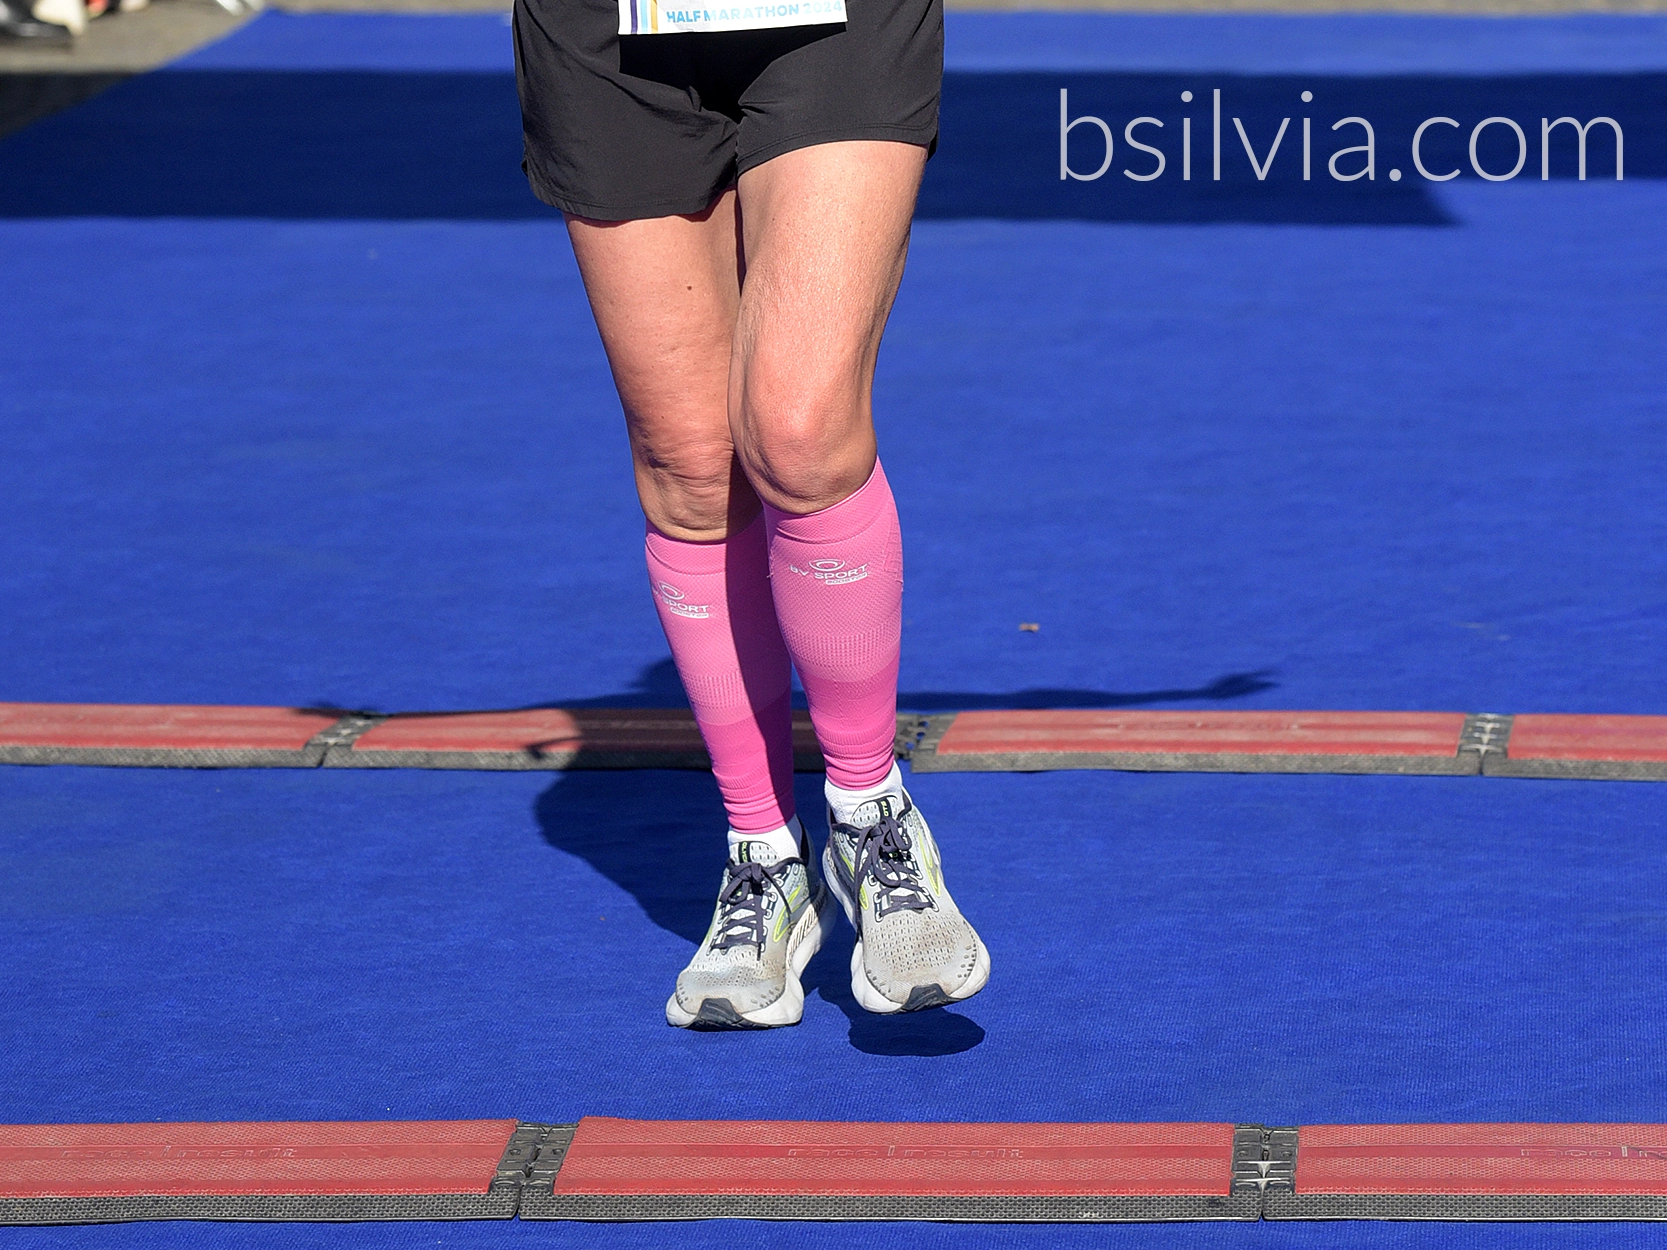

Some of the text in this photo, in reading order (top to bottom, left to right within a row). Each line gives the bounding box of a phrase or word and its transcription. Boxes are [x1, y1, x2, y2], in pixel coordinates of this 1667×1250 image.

[666, 0, 843, 23] HALF MARATHON 2024
[814, 563, 868, 579] SPORT
